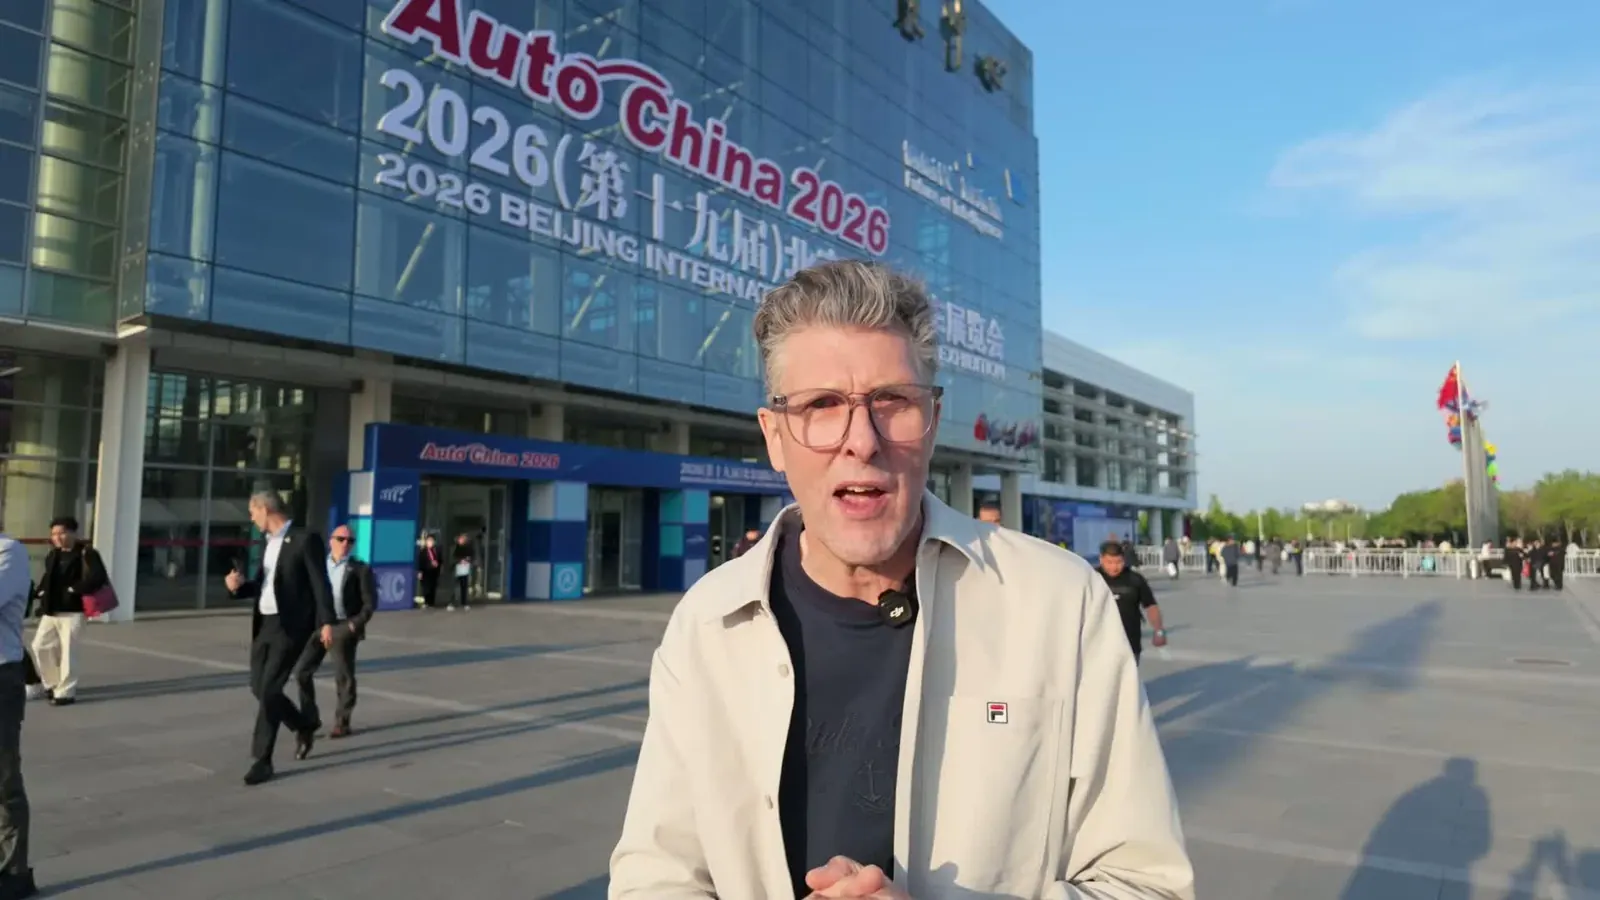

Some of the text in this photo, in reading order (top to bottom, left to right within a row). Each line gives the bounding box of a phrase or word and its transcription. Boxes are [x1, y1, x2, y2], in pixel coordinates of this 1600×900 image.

[374, 153, 493, 215] 2026
[501, 192, 639, 264] BEIJING
[376, 68, 837, 283] 2026(第十九届)北
[381, 0, 603, 120] Auto
[620, 80, 784, 210] China
[788, 167, 890, 256] 2026
[420, 442, 560, 469] Auto China 2026
